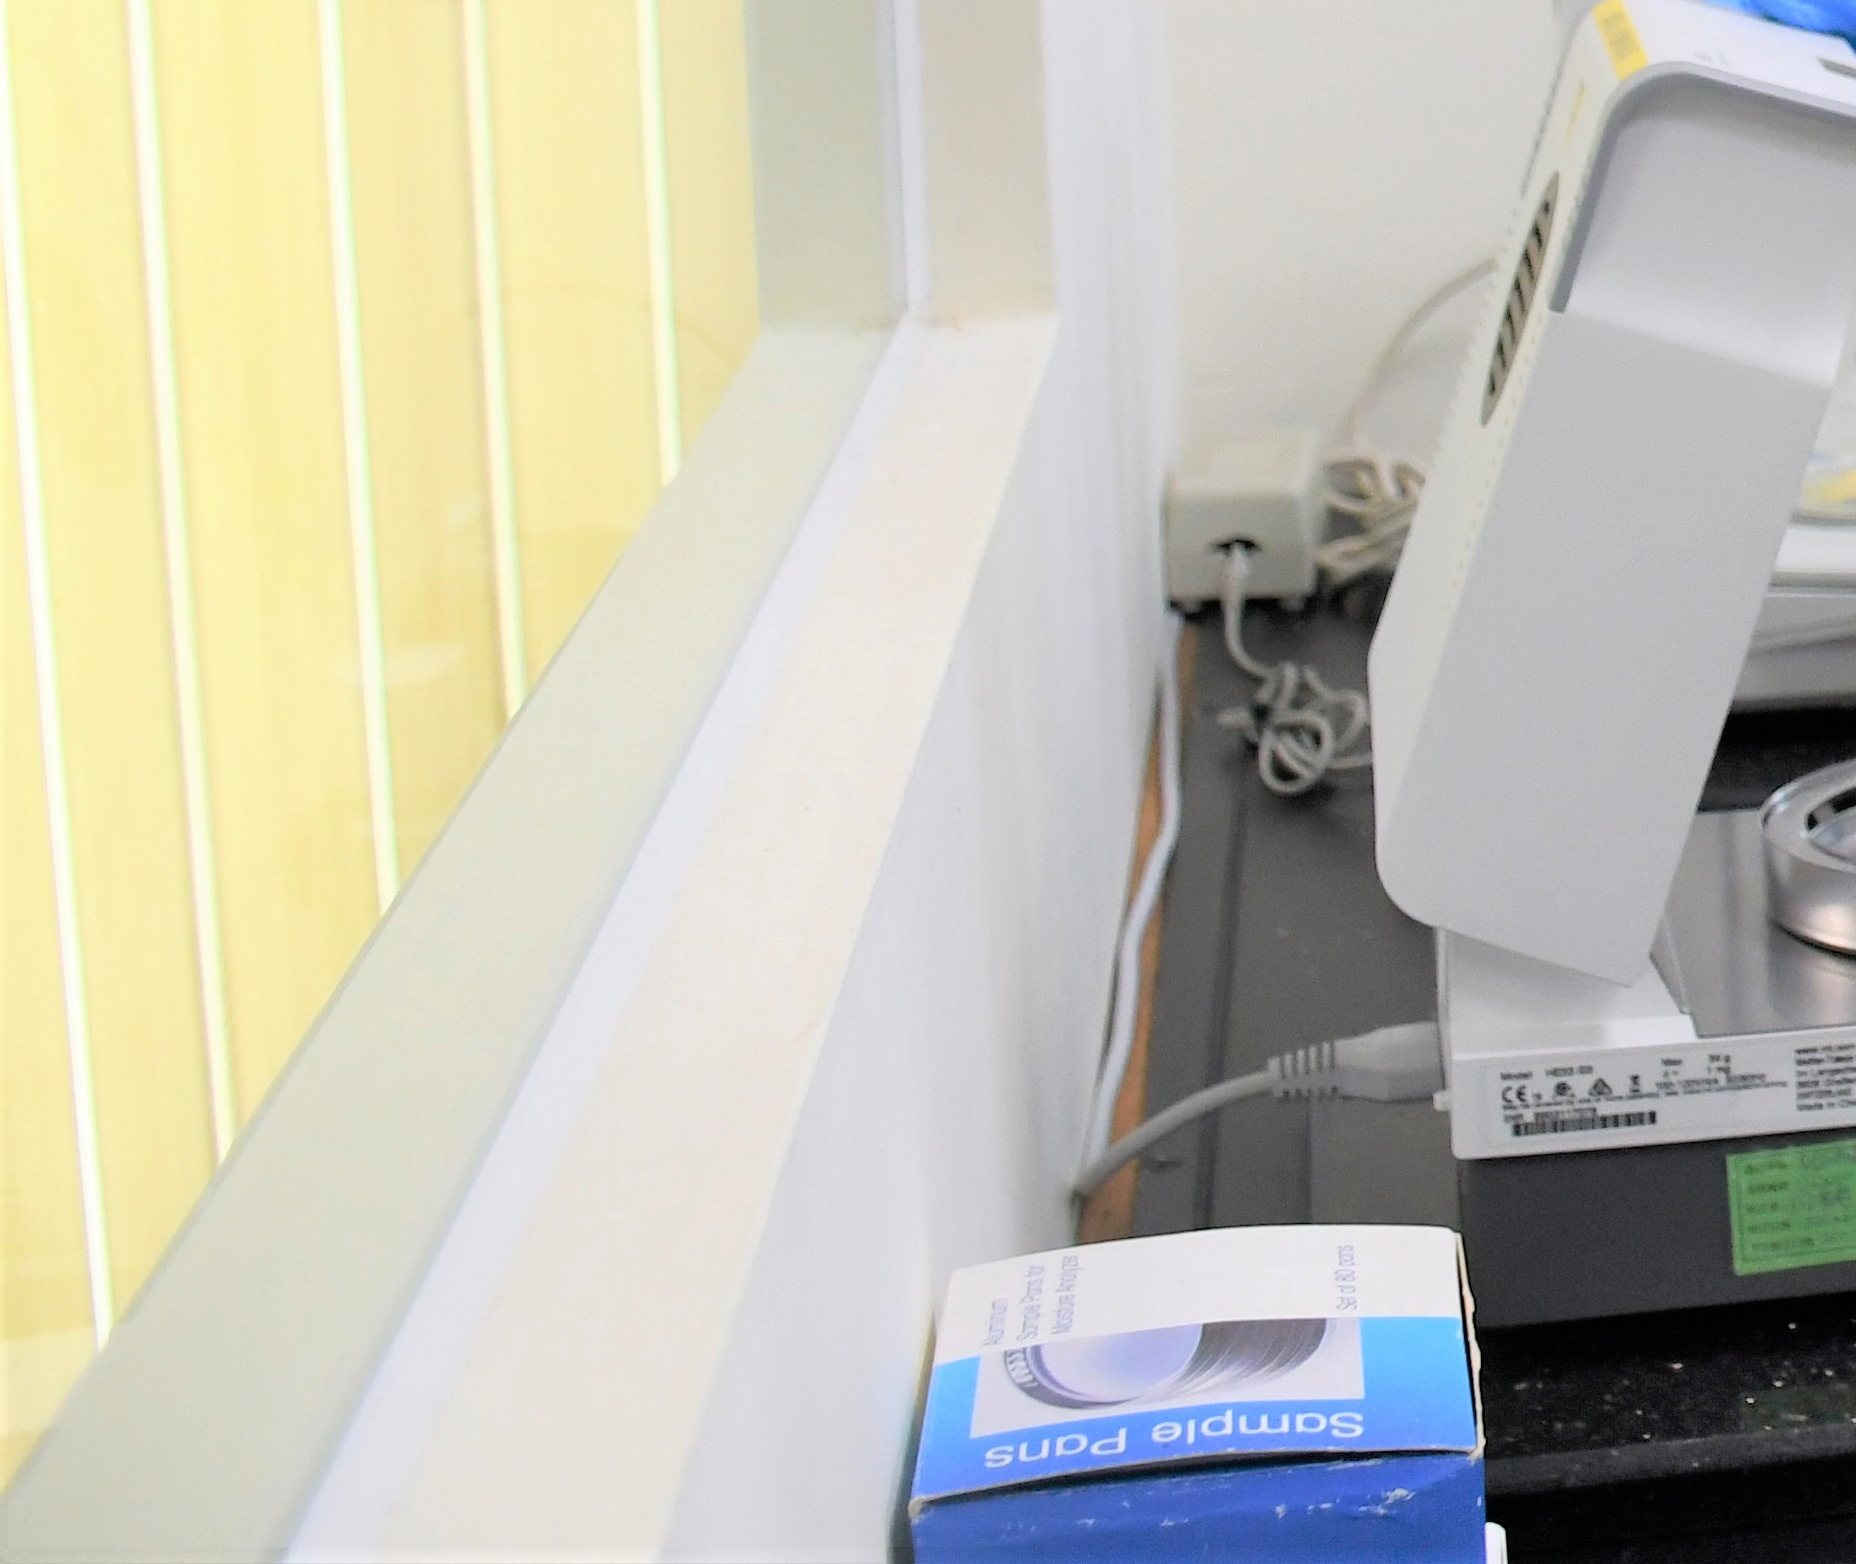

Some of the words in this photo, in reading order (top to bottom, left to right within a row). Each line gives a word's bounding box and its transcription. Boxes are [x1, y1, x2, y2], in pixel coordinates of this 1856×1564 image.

[1337, 1245, 1358, 1268] pans
[1020, 1278, 1043, 1303] Pans
[1336, 1284, 1357, 1294] of
[1335, 1296, 1358, 1311] Set
[1016, 1304, 1043, 1341] Sample
[1151, 1409, 1365, 1446] Sample
[984, 1426, 1128, 1470] Pans
